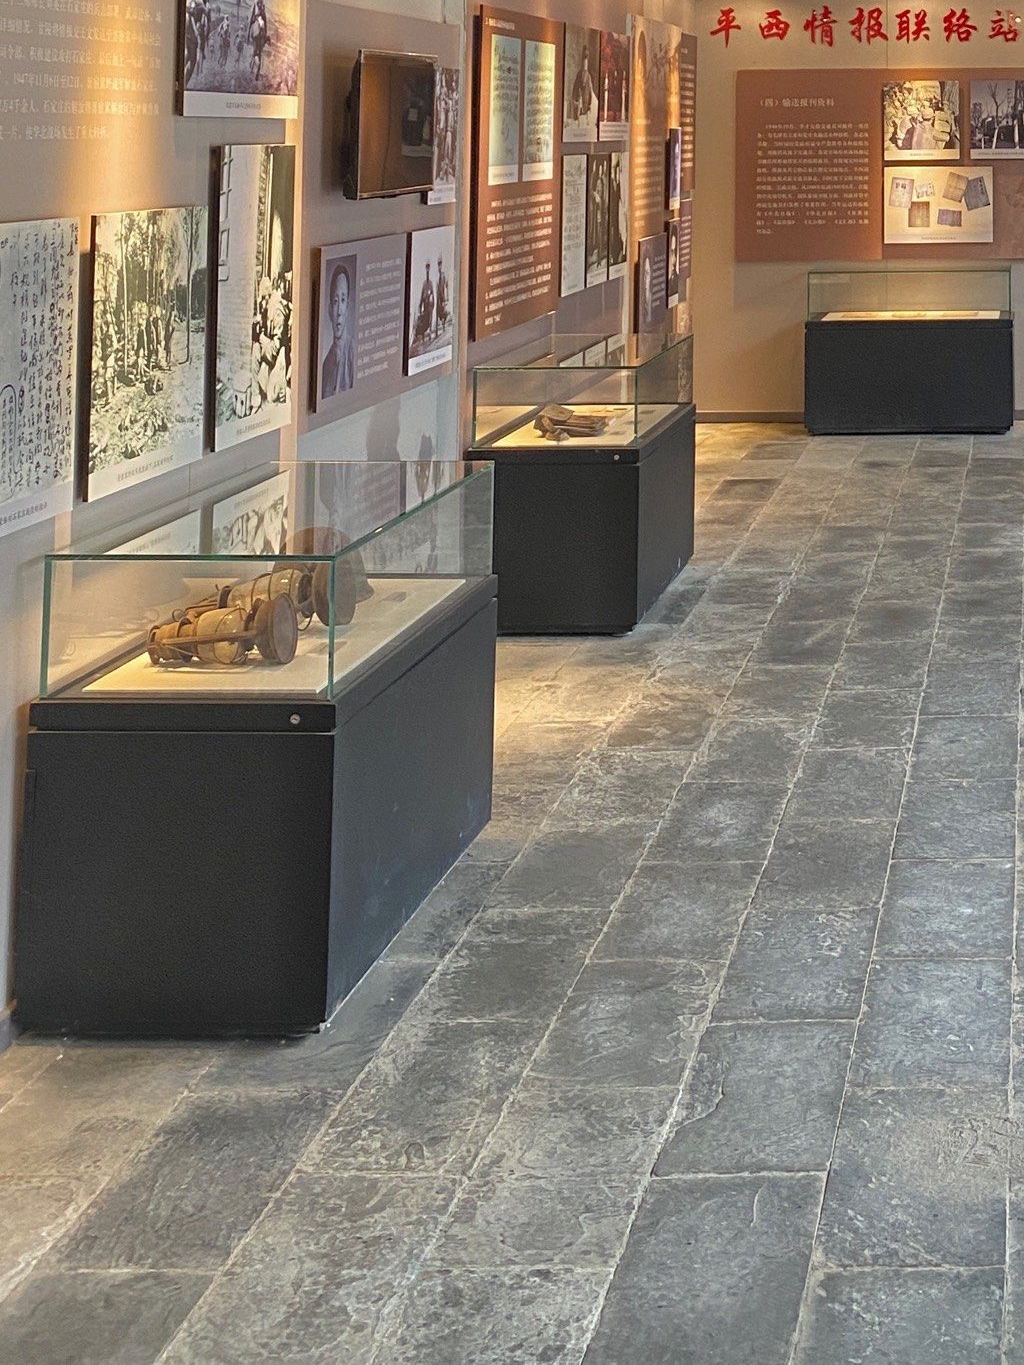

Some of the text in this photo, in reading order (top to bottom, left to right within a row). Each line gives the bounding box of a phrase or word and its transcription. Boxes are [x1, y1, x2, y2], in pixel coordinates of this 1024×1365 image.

[710, 5, 1022, 49] 平西情报联络站
